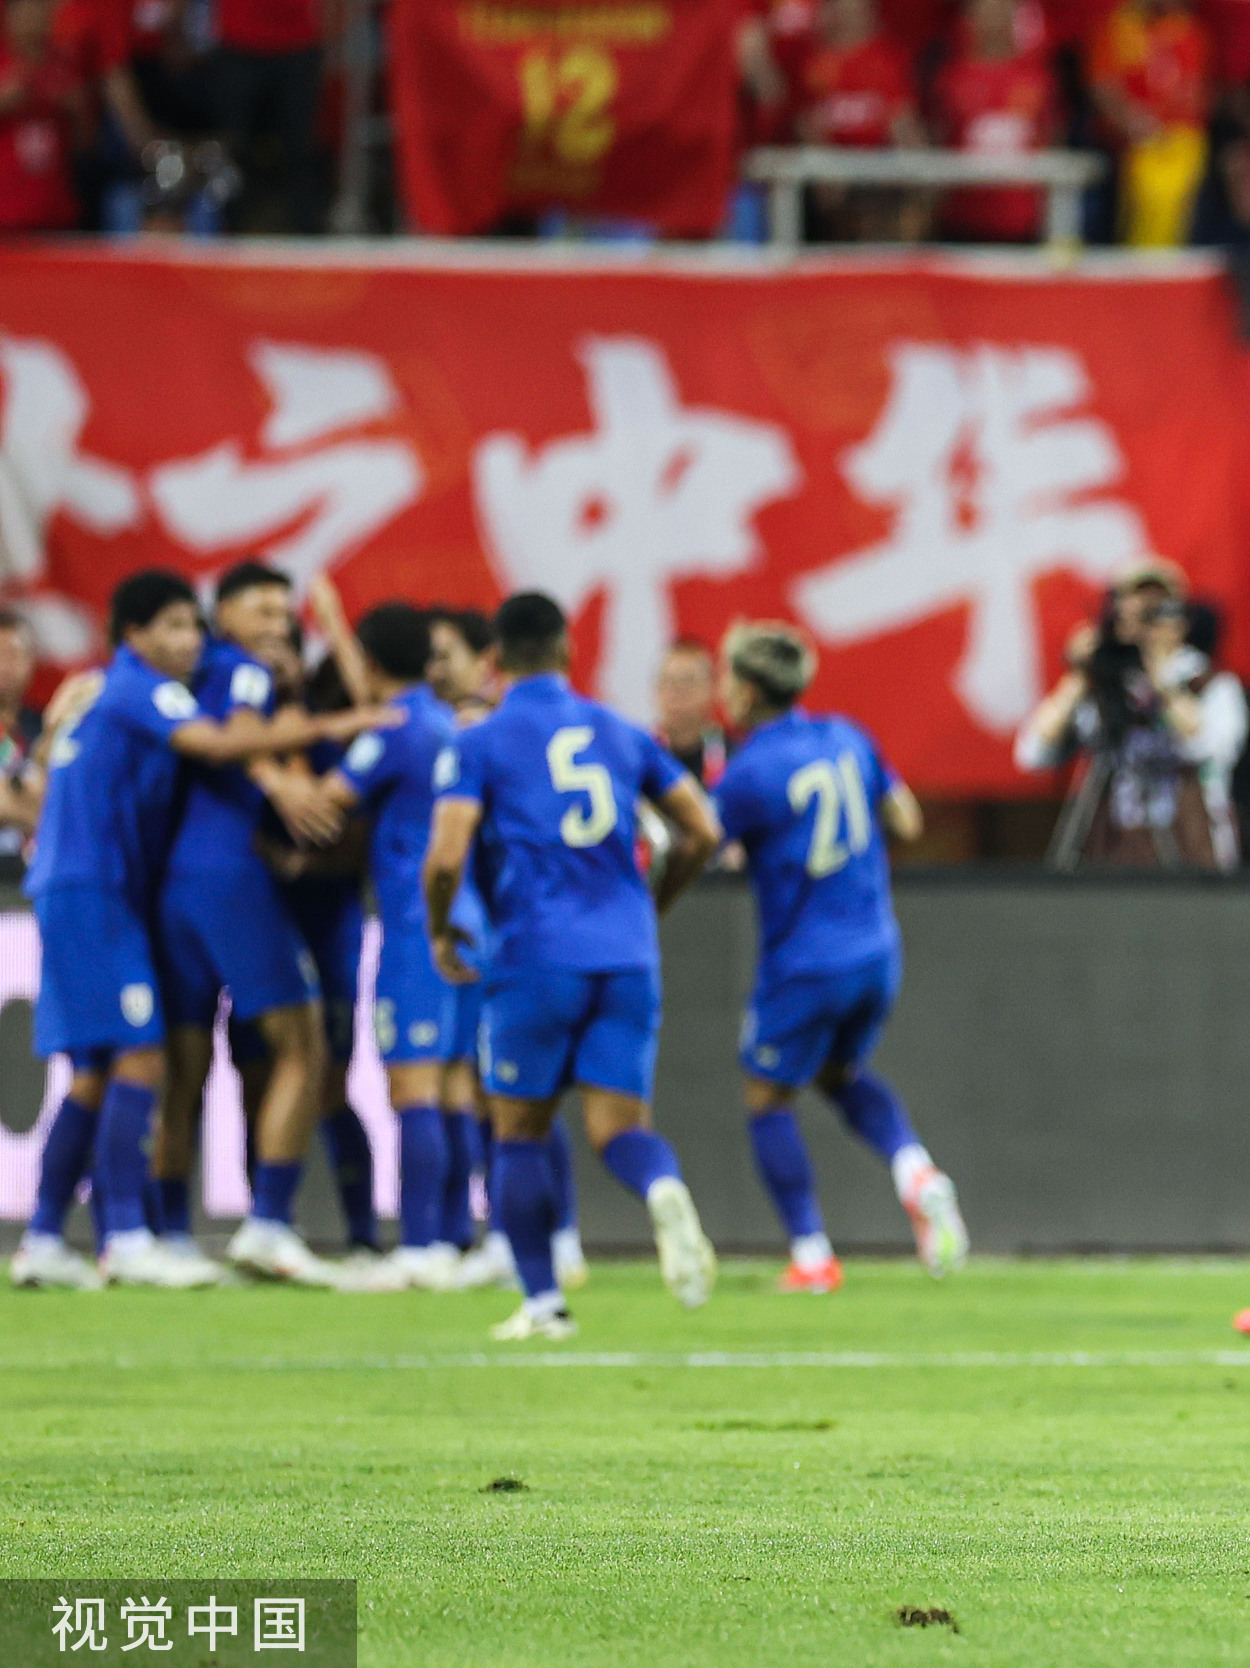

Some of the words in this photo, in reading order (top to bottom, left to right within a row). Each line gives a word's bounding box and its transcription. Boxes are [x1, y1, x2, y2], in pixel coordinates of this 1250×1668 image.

[521, 46, 616, 164] 12
[546, 725, 616, 847] 5
[786, 751, 870, 879] 21
